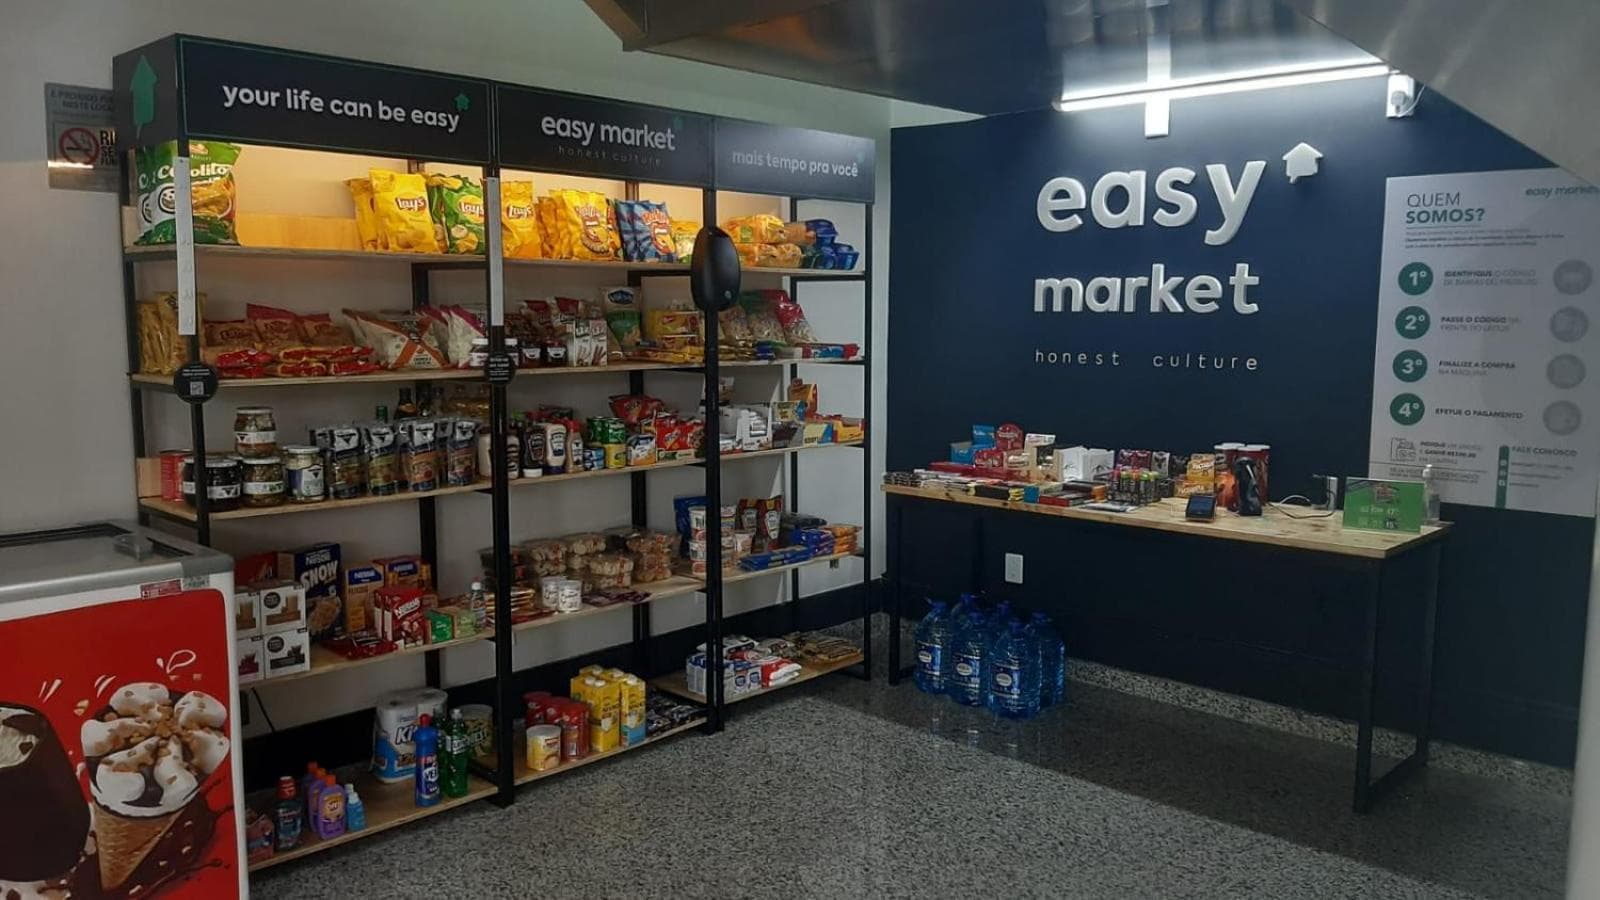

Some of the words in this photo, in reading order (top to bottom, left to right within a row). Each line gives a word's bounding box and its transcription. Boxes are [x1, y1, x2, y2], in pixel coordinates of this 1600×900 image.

[222, 84, 281, 108] your
[286, 88, 324, 112] life
[330, 98, 373, 119] can
[378, 100, 406, 122] be
[411, 109, 460, 132] easy
[541, 115, 596, 145] easy
[600, 124, 676, 151] market
[558, 145, 609, 161] honest
[732, 149, 763, 166] mais
[766, 154, 807, 173] tempo
[809, 159, 830, 175] pra
[832, 160, 859, 177] você
[1407, 191, 1461, 208] QUEM
[1525, 187, 1553, 199] easy
[1036, 160, 1267, 246] easy
[1405, 208, 1486, 224] SOMOS?
[1444, 269, 1493, 278] IDENTIFIQUE
[1034, 263, 1260, 315] market
[1035, 349, 1121, 366] honest
[1152, 352, 1259, 370] culture
[1439, 360, 1472, 368] FINALIZE
[1480, 361, 1516, 370] COMPRA
[1435, 408, 1463, 417] EFETUE
[1464, 409, 1472, 417] O
[1512, 445, 1533, 454] FALE
[1534, 447, 1579, 457] CONOSCO
[300, 560, 338, 593] SNOW
